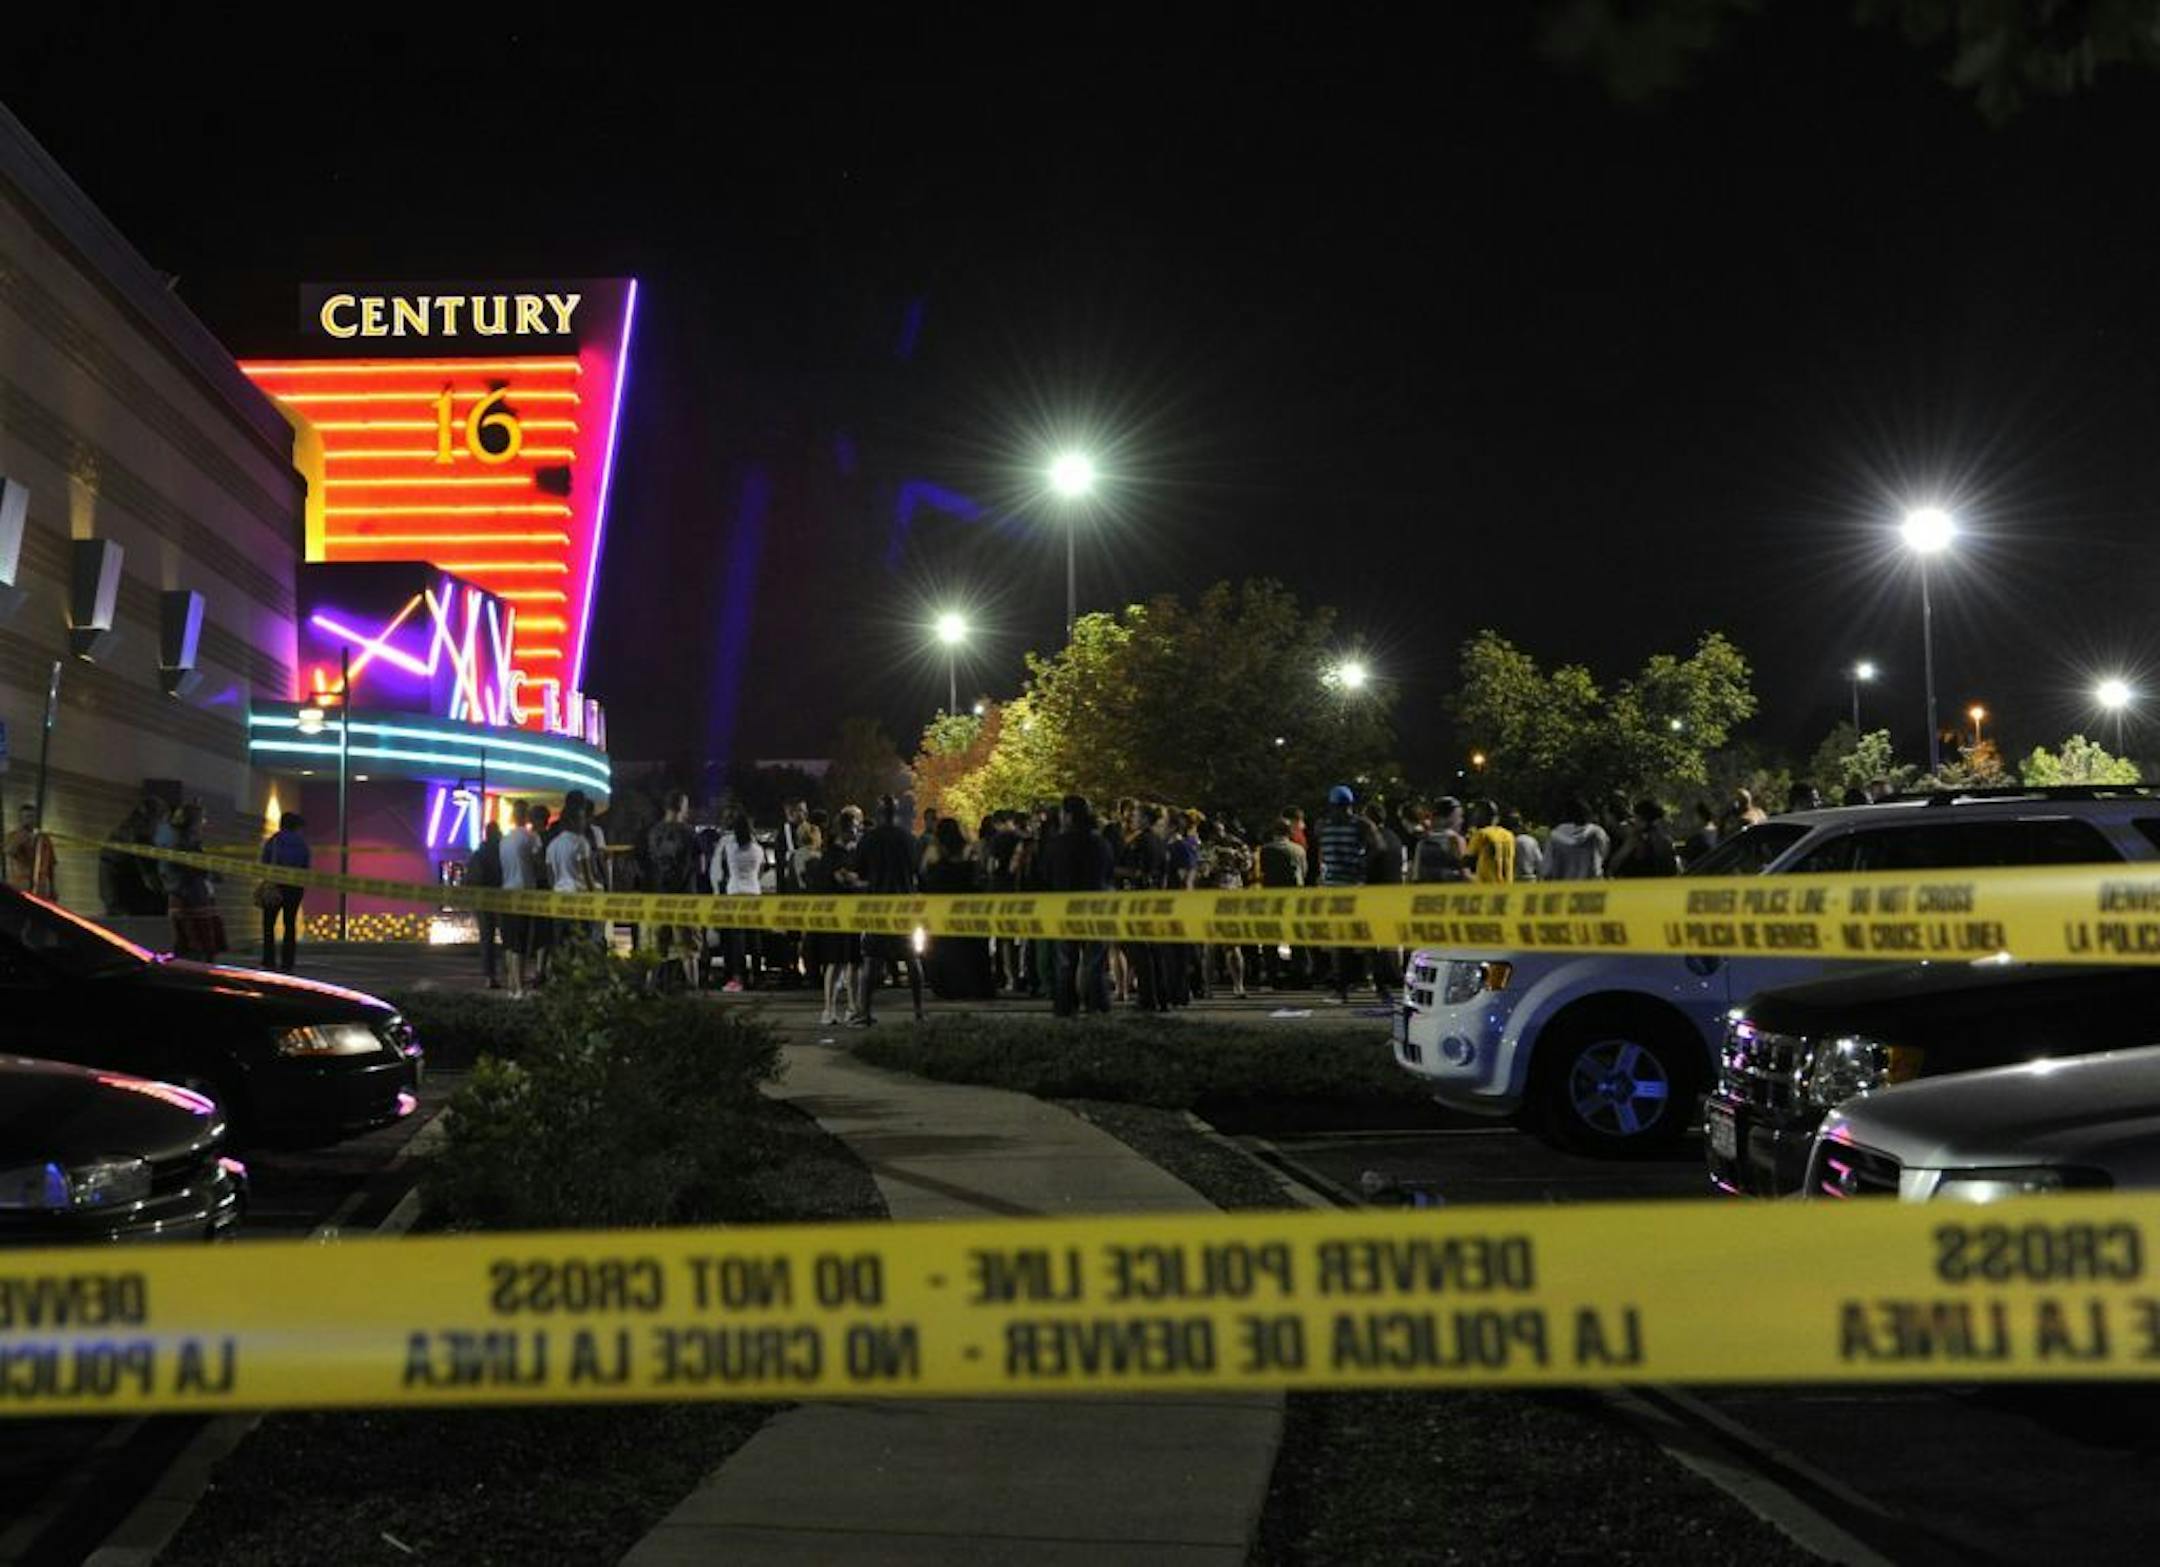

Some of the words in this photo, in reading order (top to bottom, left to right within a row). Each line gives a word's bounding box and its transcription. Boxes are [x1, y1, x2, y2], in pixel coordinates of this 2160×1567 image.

[320, 294, 581, 337] CENTURY
[430, 385, 522, 464] 16
[1687, 890, 1738, 913] DENVER
[1744, 889, 1788, 914] POLICE
[1917, 884, 1973, 914] CROSS
[1664, 922, 1681, 947] LA
[1684, 922, 1737, 947] POLICIA
[1763, 923, 1820, 949] DENVER
[1869, 922, 1924, 950] CRUCE
[1927, 922, 1950, 950] LA
[1954, 922, 2008, 950] LINEA
[2064, 921, 2093, 953] LA
